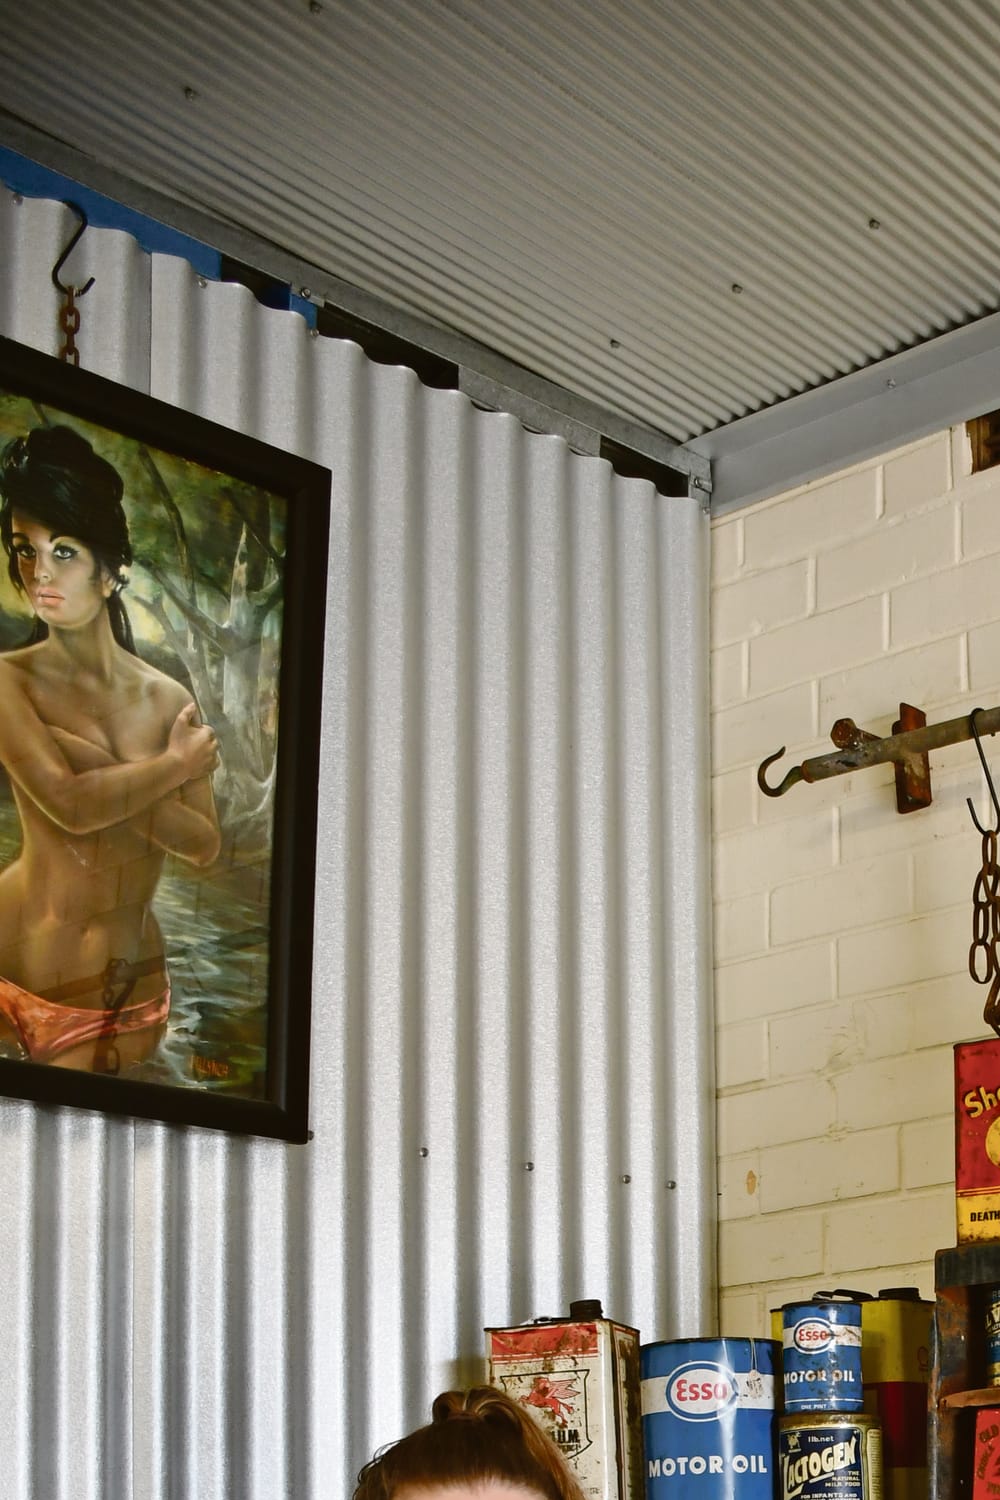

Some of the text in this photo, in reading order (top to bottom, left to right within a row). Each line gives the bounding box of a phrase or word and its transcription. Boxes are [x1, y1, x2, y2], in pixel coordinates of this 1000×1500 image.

[969, 1209, 1000, 1223] DEATH
[783, 1369, 855, 1385] MOTOR OIL
[648, 1454, 768, 1479] MOTOR OIL
